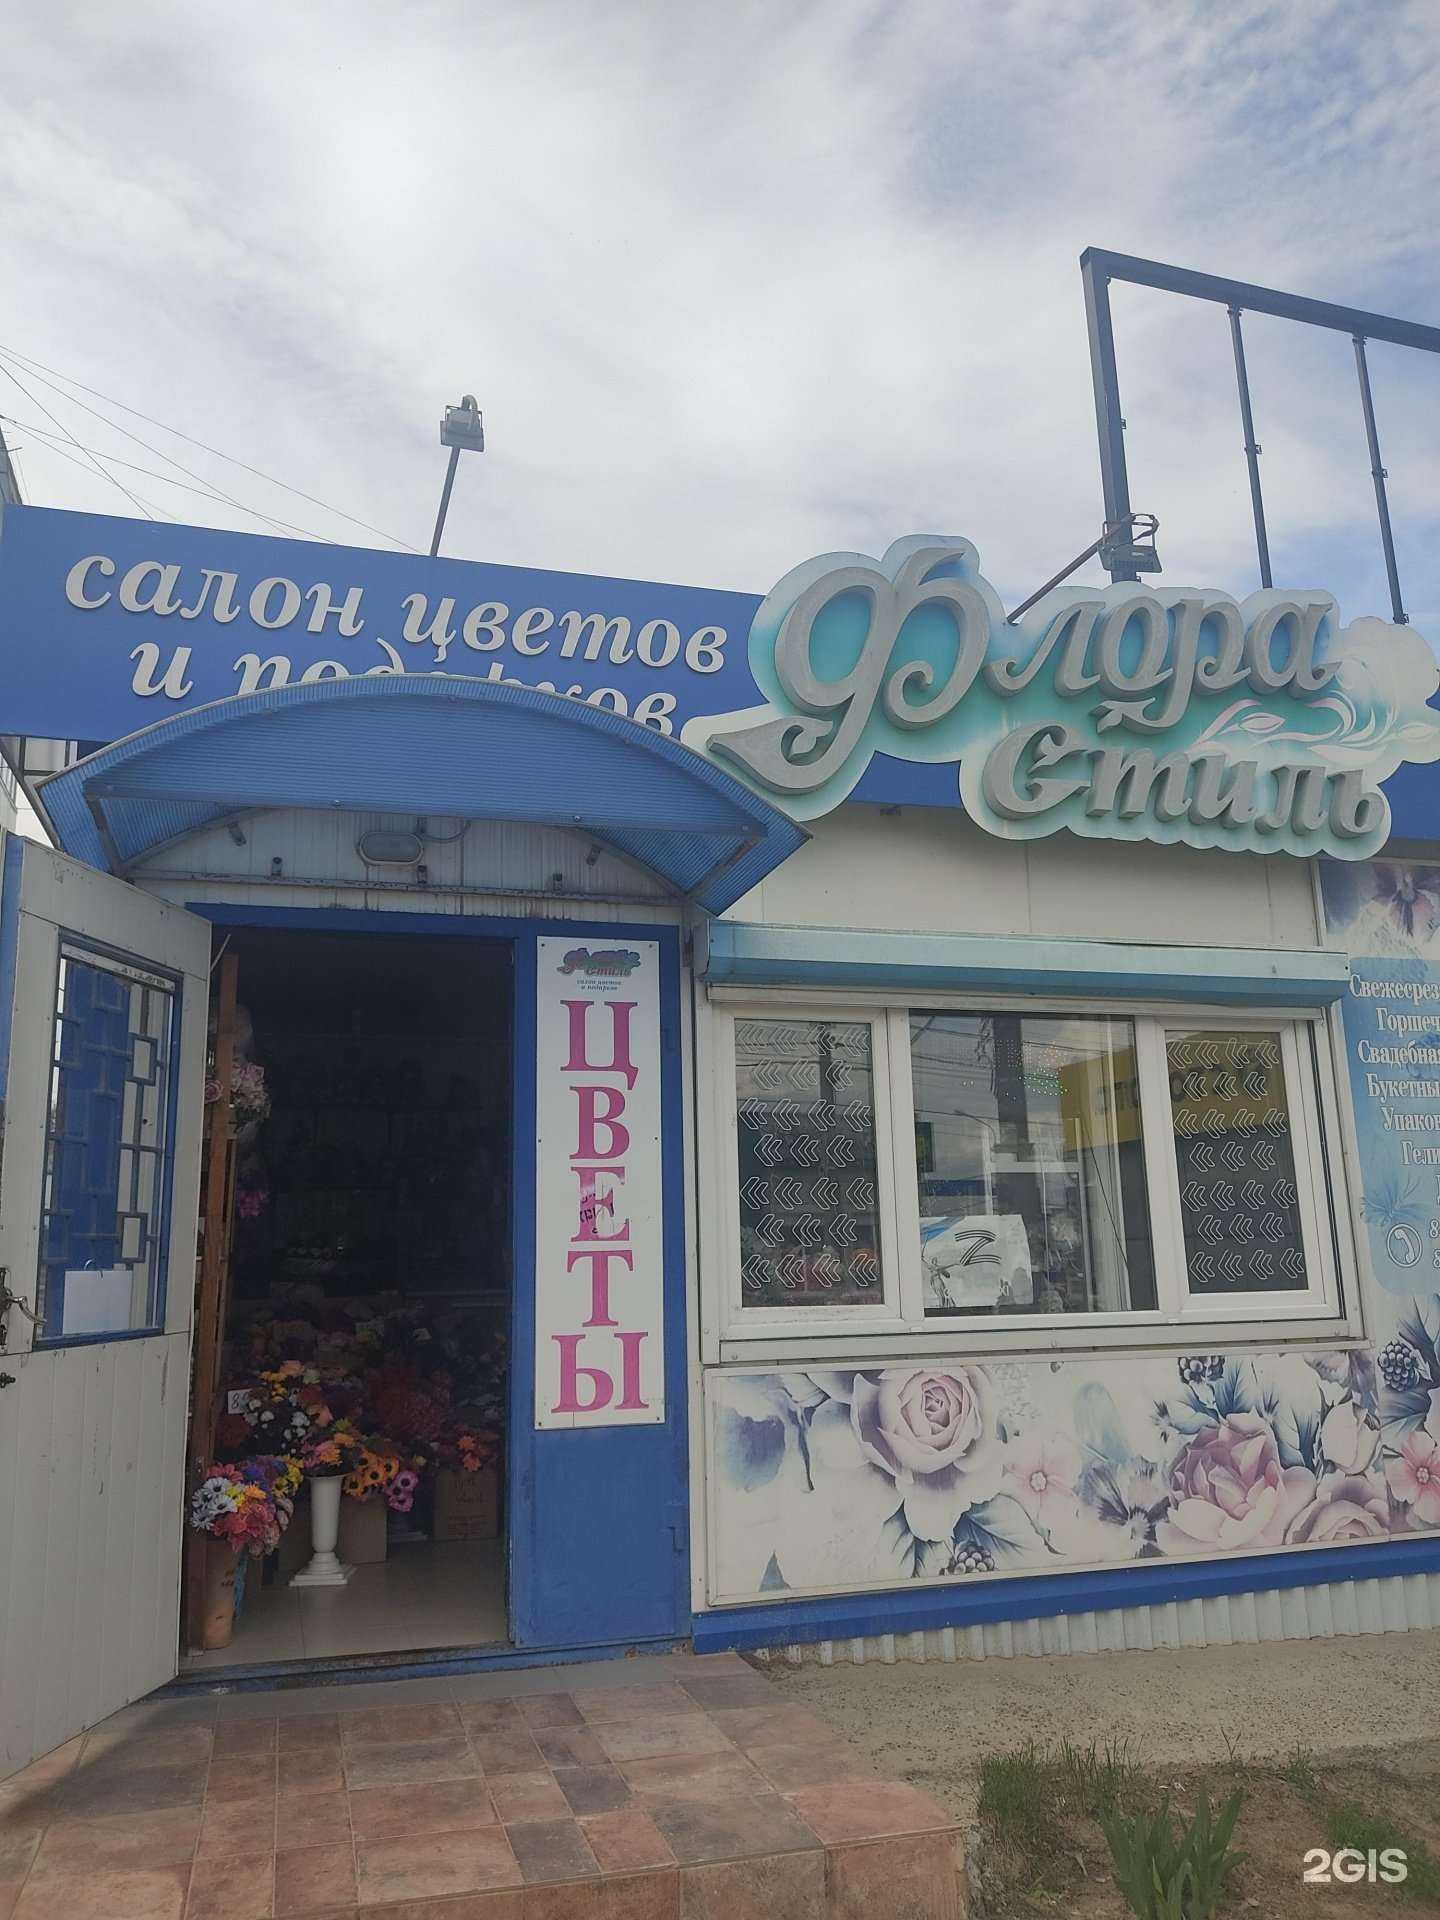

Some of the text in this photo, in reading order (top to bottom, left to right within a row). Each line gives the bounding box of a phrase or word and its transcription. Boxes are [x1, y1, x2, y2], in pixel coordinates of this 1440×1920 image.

[65, 554, 728, 674] салон цветов
[130, 641, 193, 699] и
[706, 547, 1342, 795] Флора
[982, 722, 1389, 840] Стиль
[551, 999, 650, 1414] ЦВЕТЫ
